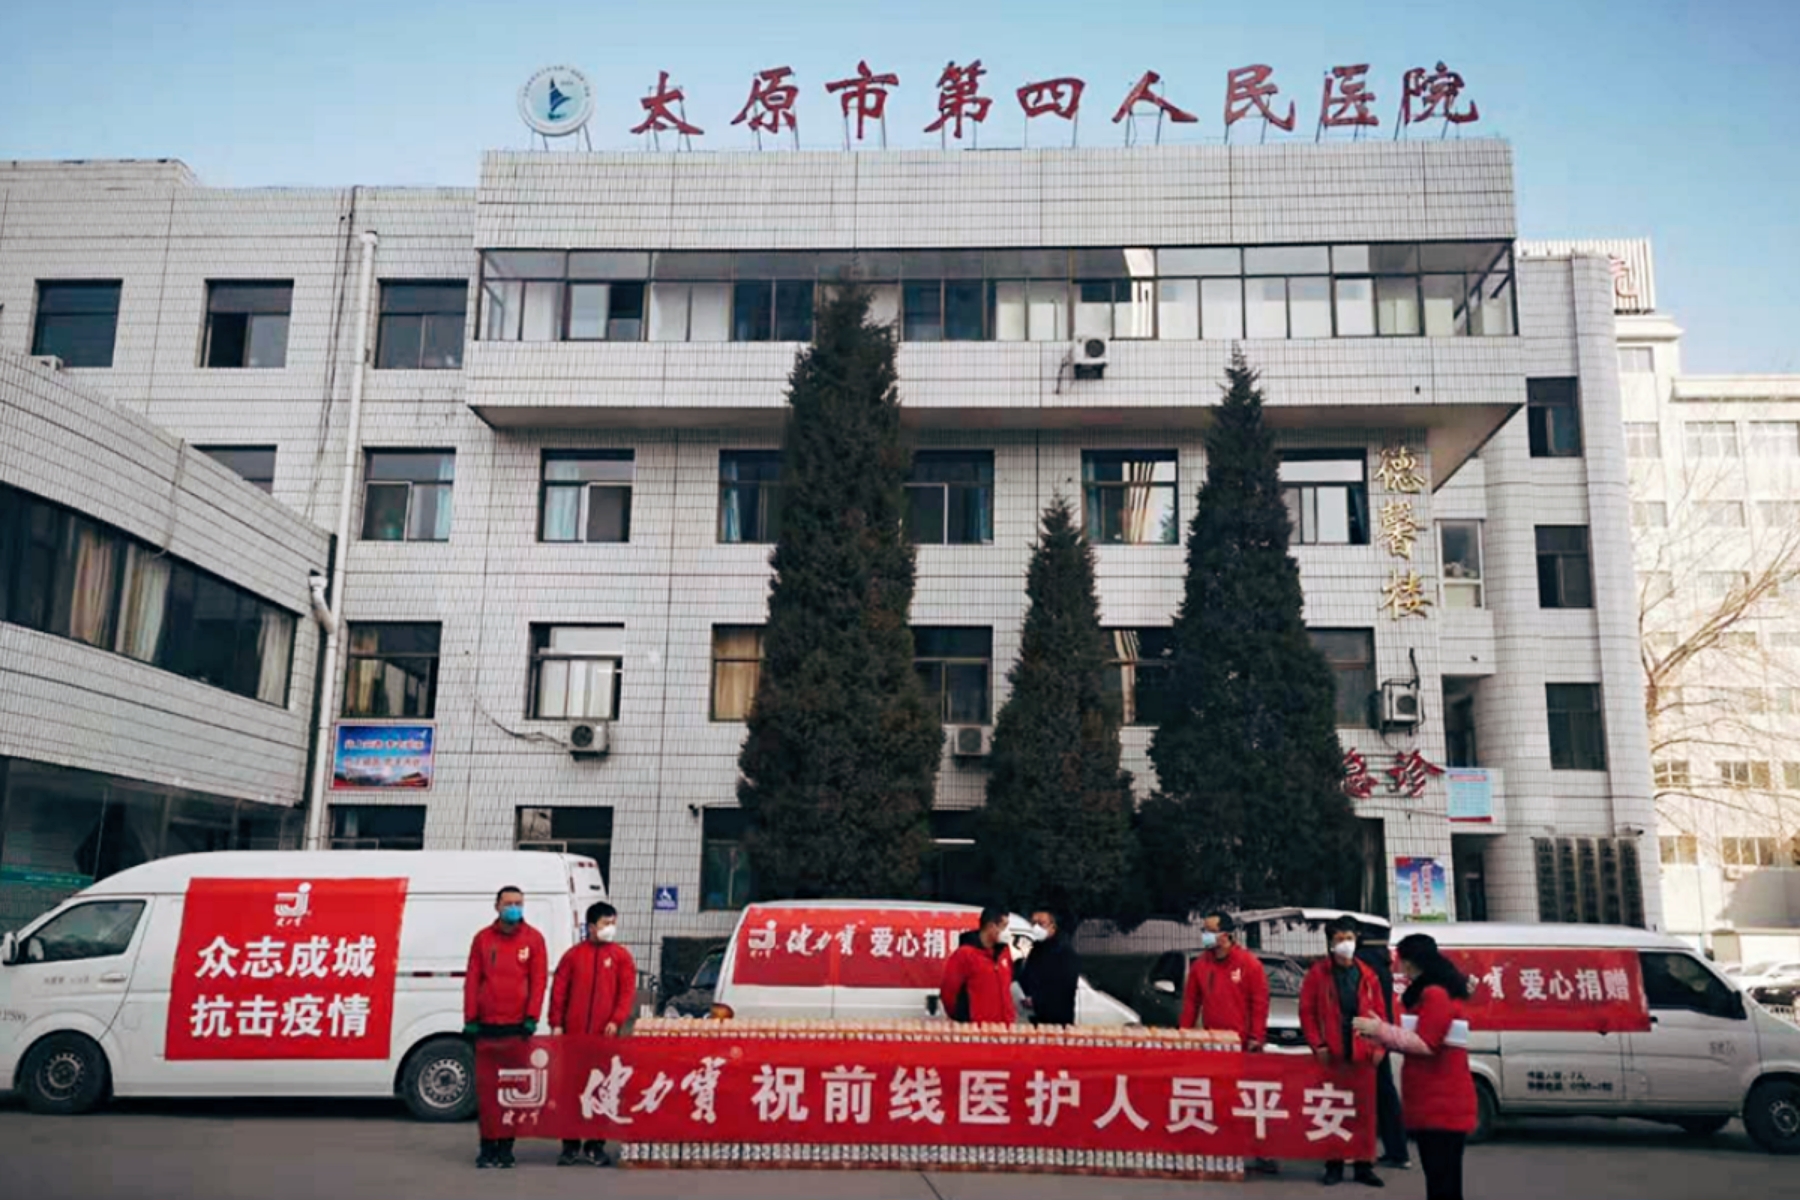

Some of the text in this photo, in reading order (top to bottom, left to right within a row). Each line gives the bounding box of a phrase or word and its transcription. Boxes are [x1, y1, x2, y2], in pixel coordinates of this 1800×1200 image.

[629, 60, 1480, 141] 太原市第四人民医院
[195, 935, 376, 979] 众志成城
[1520, 967, 1630, 1001] 爱心捐赠
[190, 993, 371, 1038] 抗击疫情
[751, 1064, 1357, 1143] 祝前线医护人员平安
